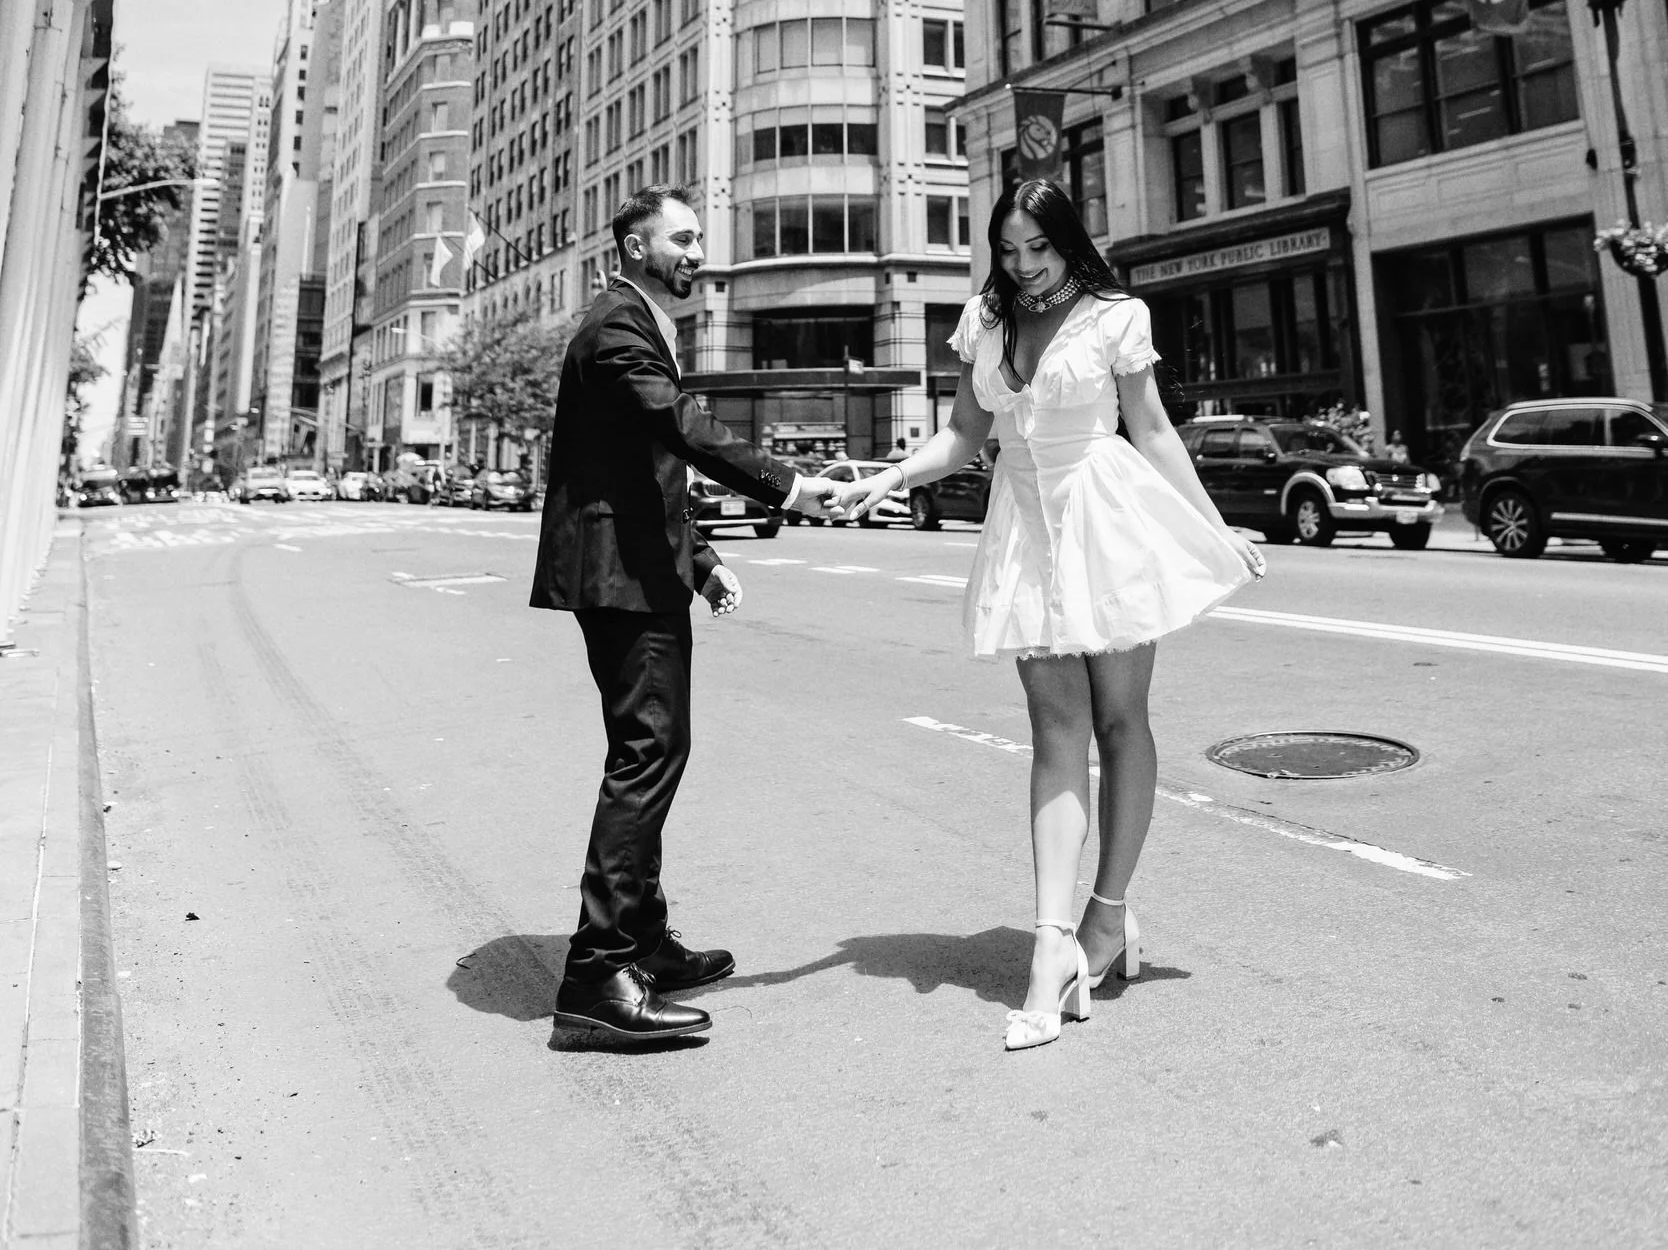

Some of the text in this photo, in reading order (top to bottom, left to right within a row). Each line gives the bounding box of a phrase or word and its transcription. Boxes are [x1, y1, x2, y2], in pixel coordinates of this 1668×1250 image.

[1134, 232, 1322, 284] THE NEW YORK PUBLIC LIBRARY
